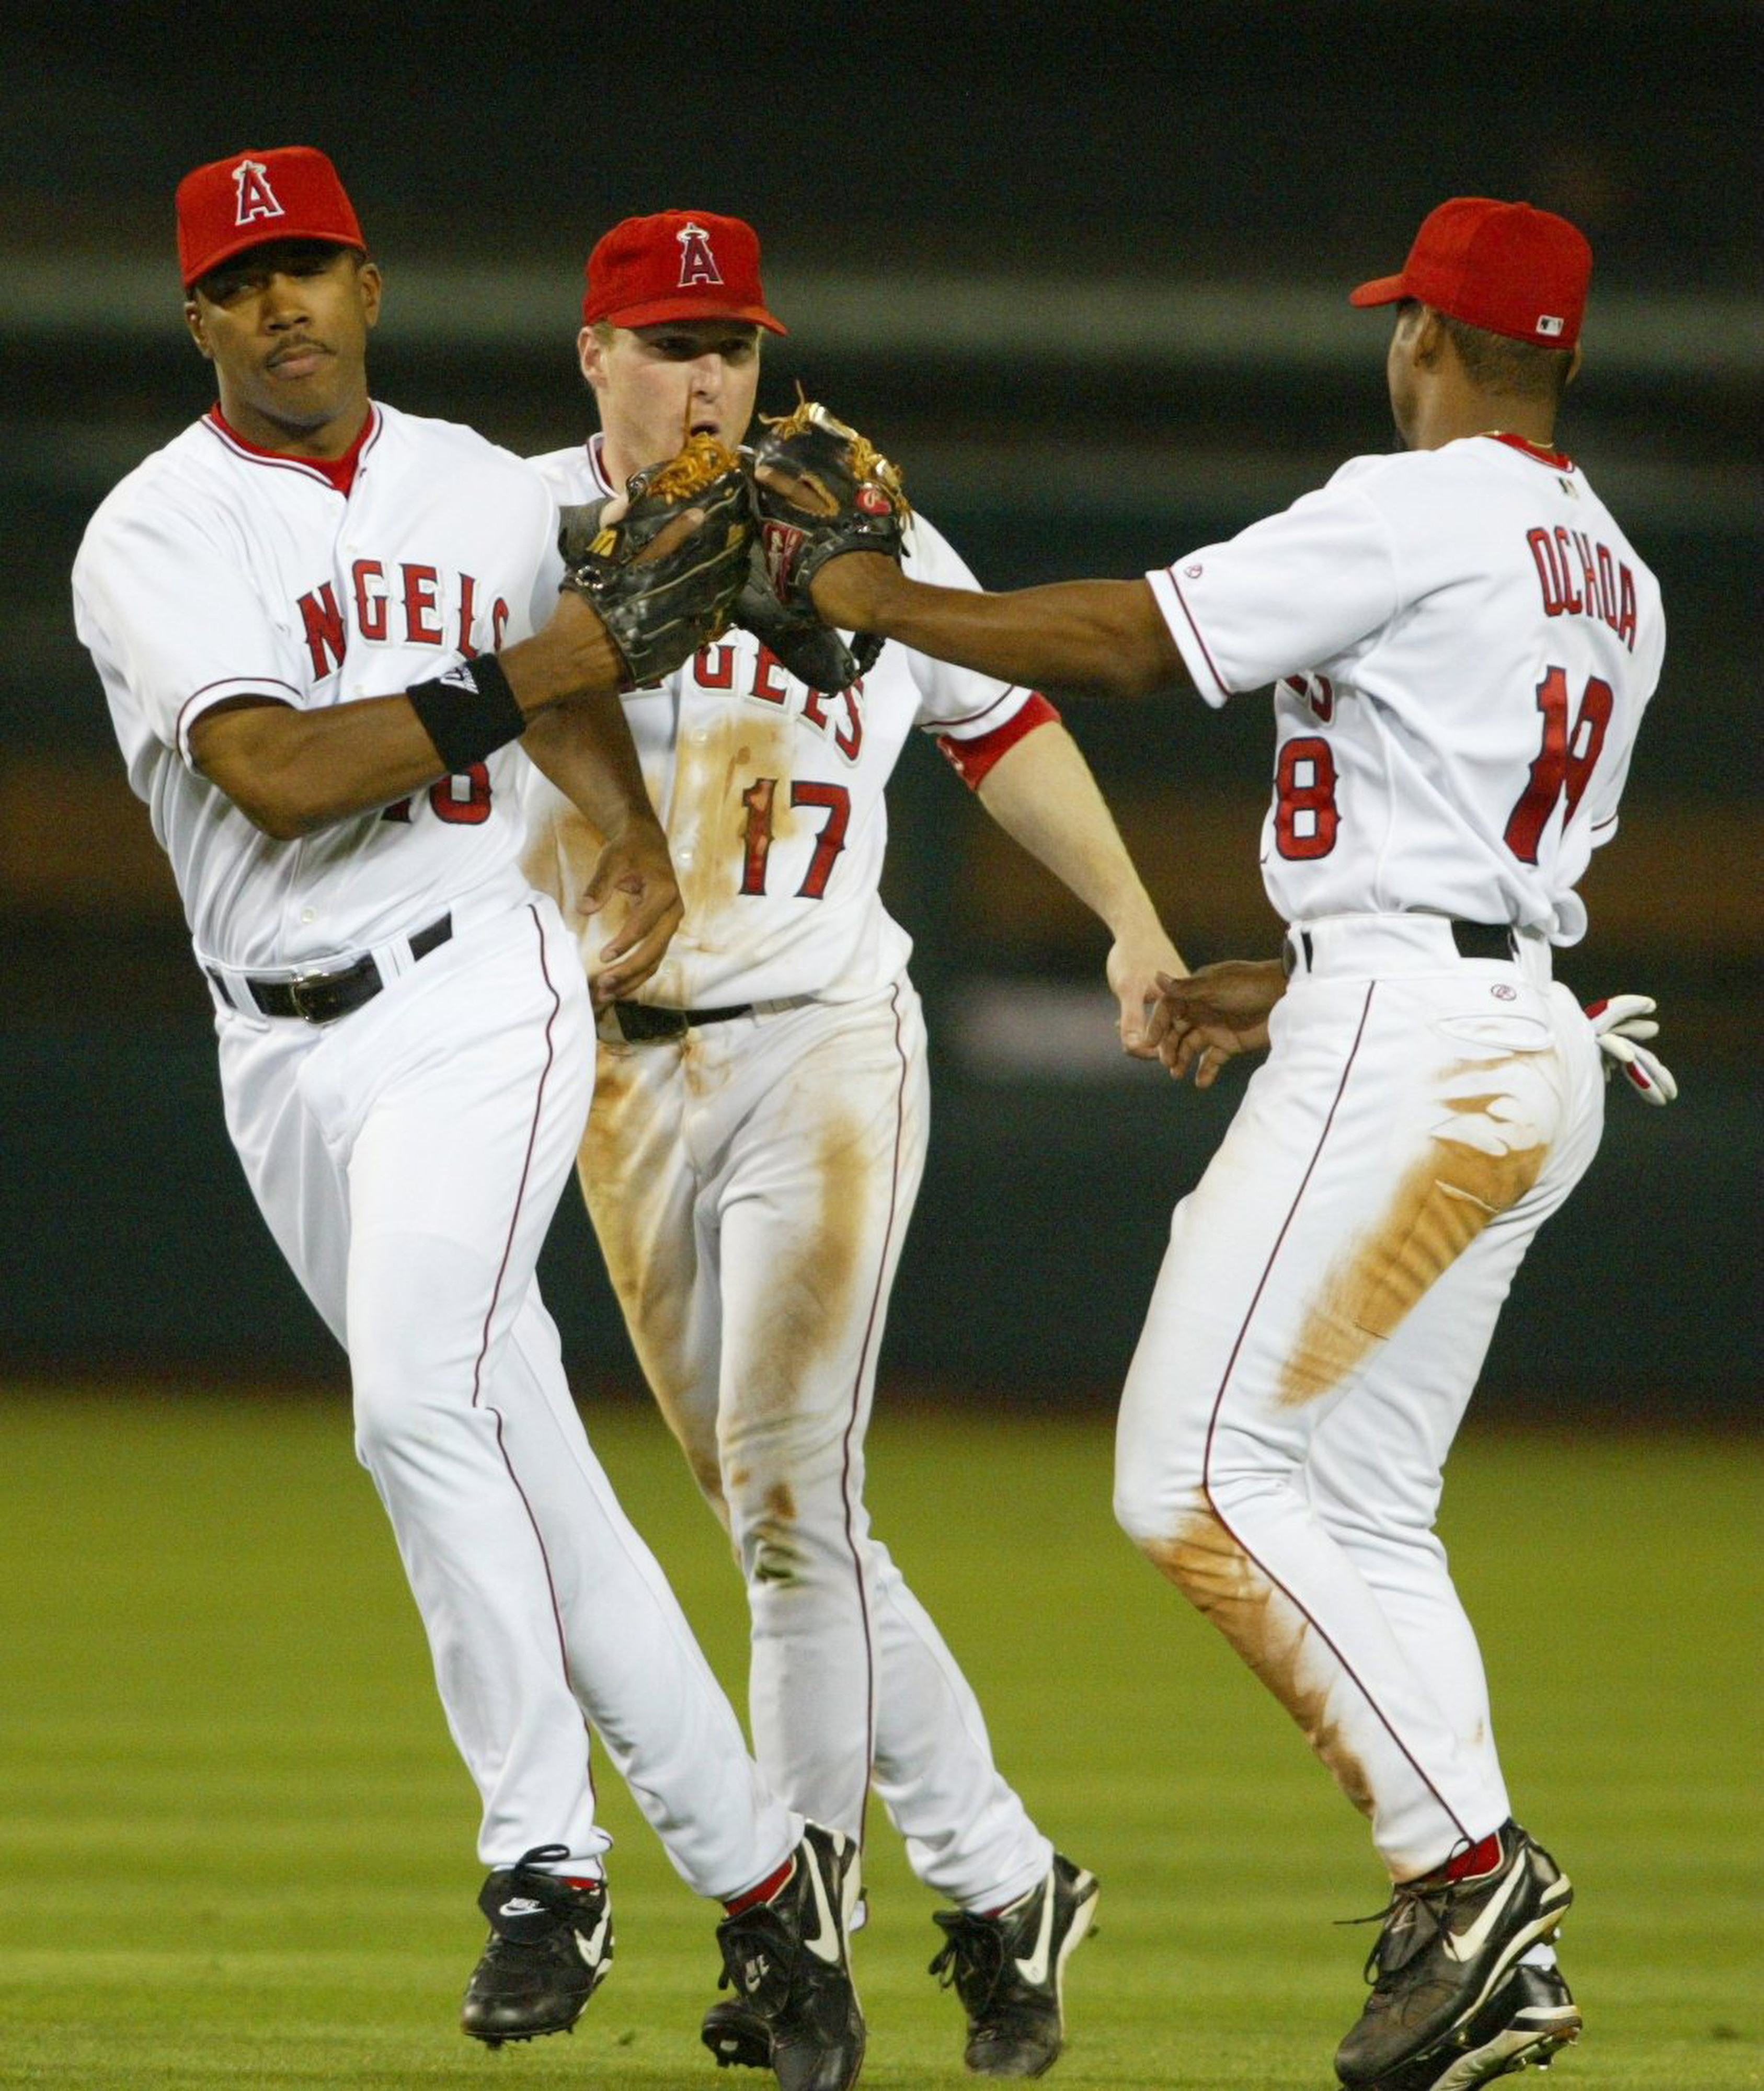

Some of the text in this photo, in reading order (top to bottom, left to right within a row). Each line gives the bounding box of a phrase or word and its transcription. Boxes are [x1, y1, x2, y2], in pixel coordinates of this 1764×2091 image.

[232, 159, 285, 226] A
[677, 222, 724, 288] A
[1526, 525, 1637, 654] OCHOA
[738, 777, 851, 900] 17
[1260, 736, 1342, 861] 8
